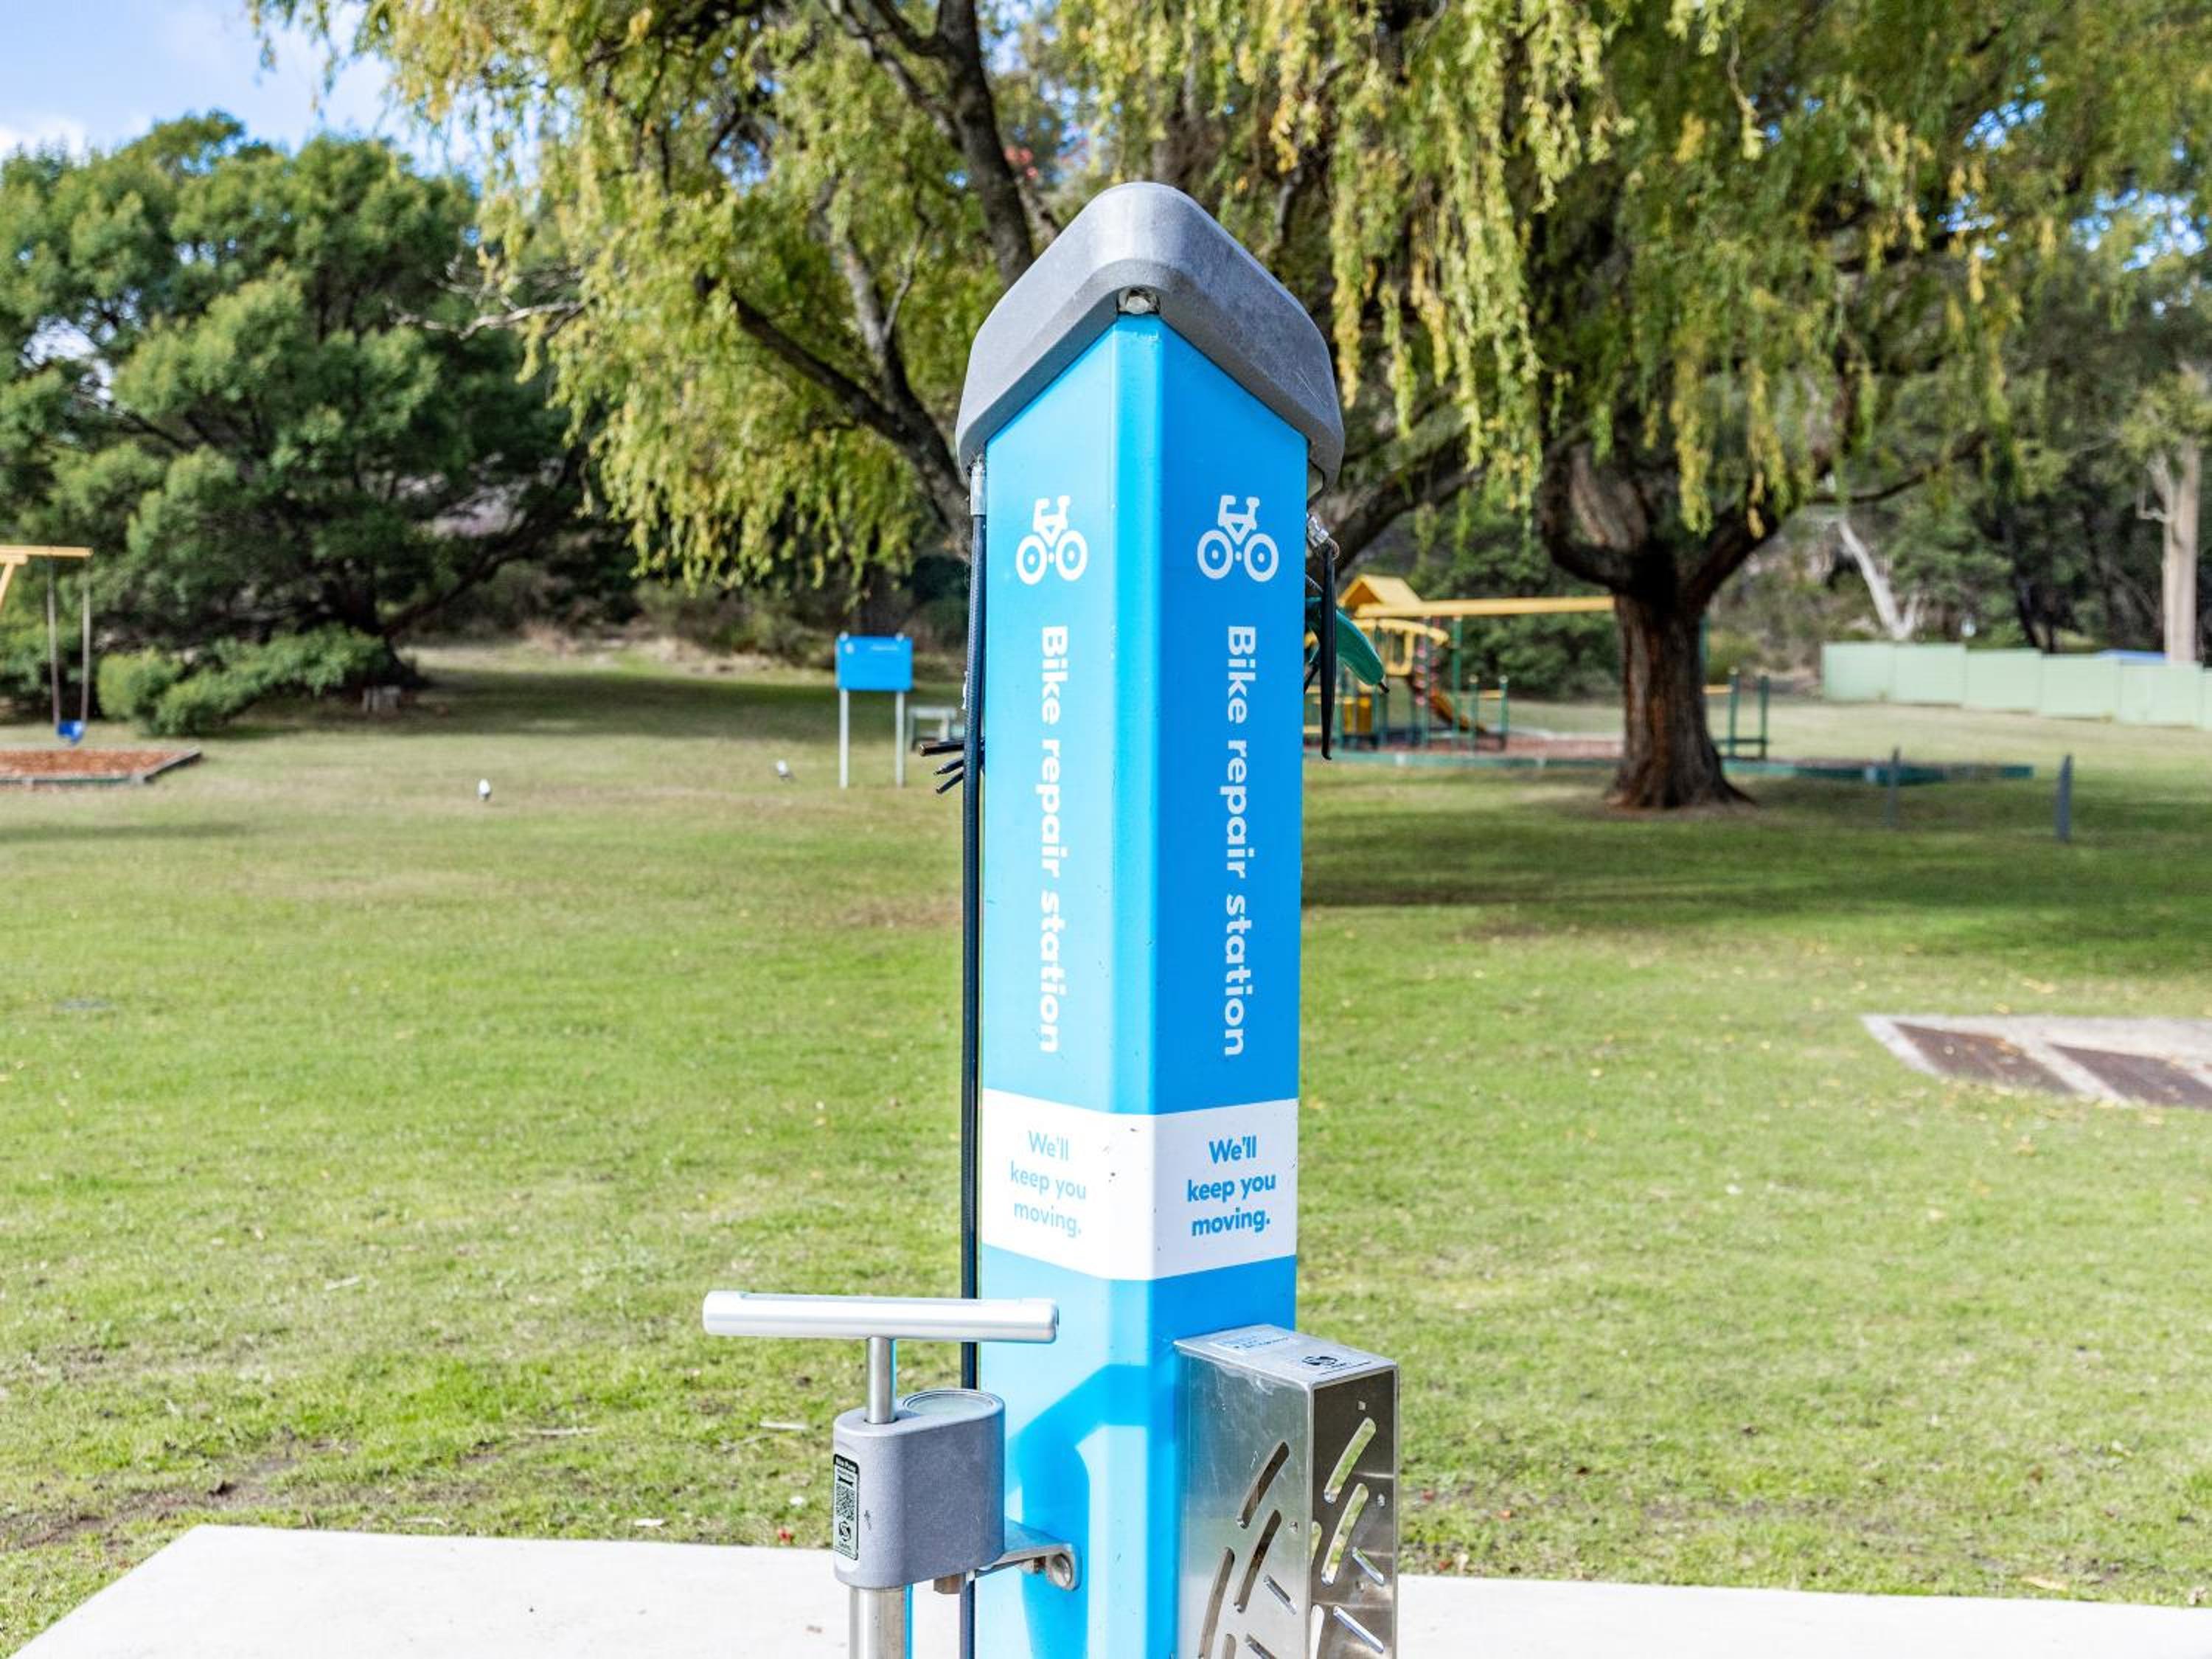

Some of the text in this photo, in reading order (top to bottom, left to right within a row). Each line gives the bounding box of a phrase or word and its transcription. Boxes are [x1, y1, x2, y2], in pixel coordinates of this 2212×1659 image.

[1036, 626, 1068, 1052] Bike repair station
[1220, 626, 1256, 1056] Bike repair station
[1029, 1130, 1068, 1161] We'll
[1208, 1135, 1256, 1164] We'll
[1010, 1161, 1086, 1201] keep you
[1187, 1175, 1276, 1203] keep you
[1014, 1201, 1082, 1238] moving.
[1192, 1207, 1270, 1236] moving.
